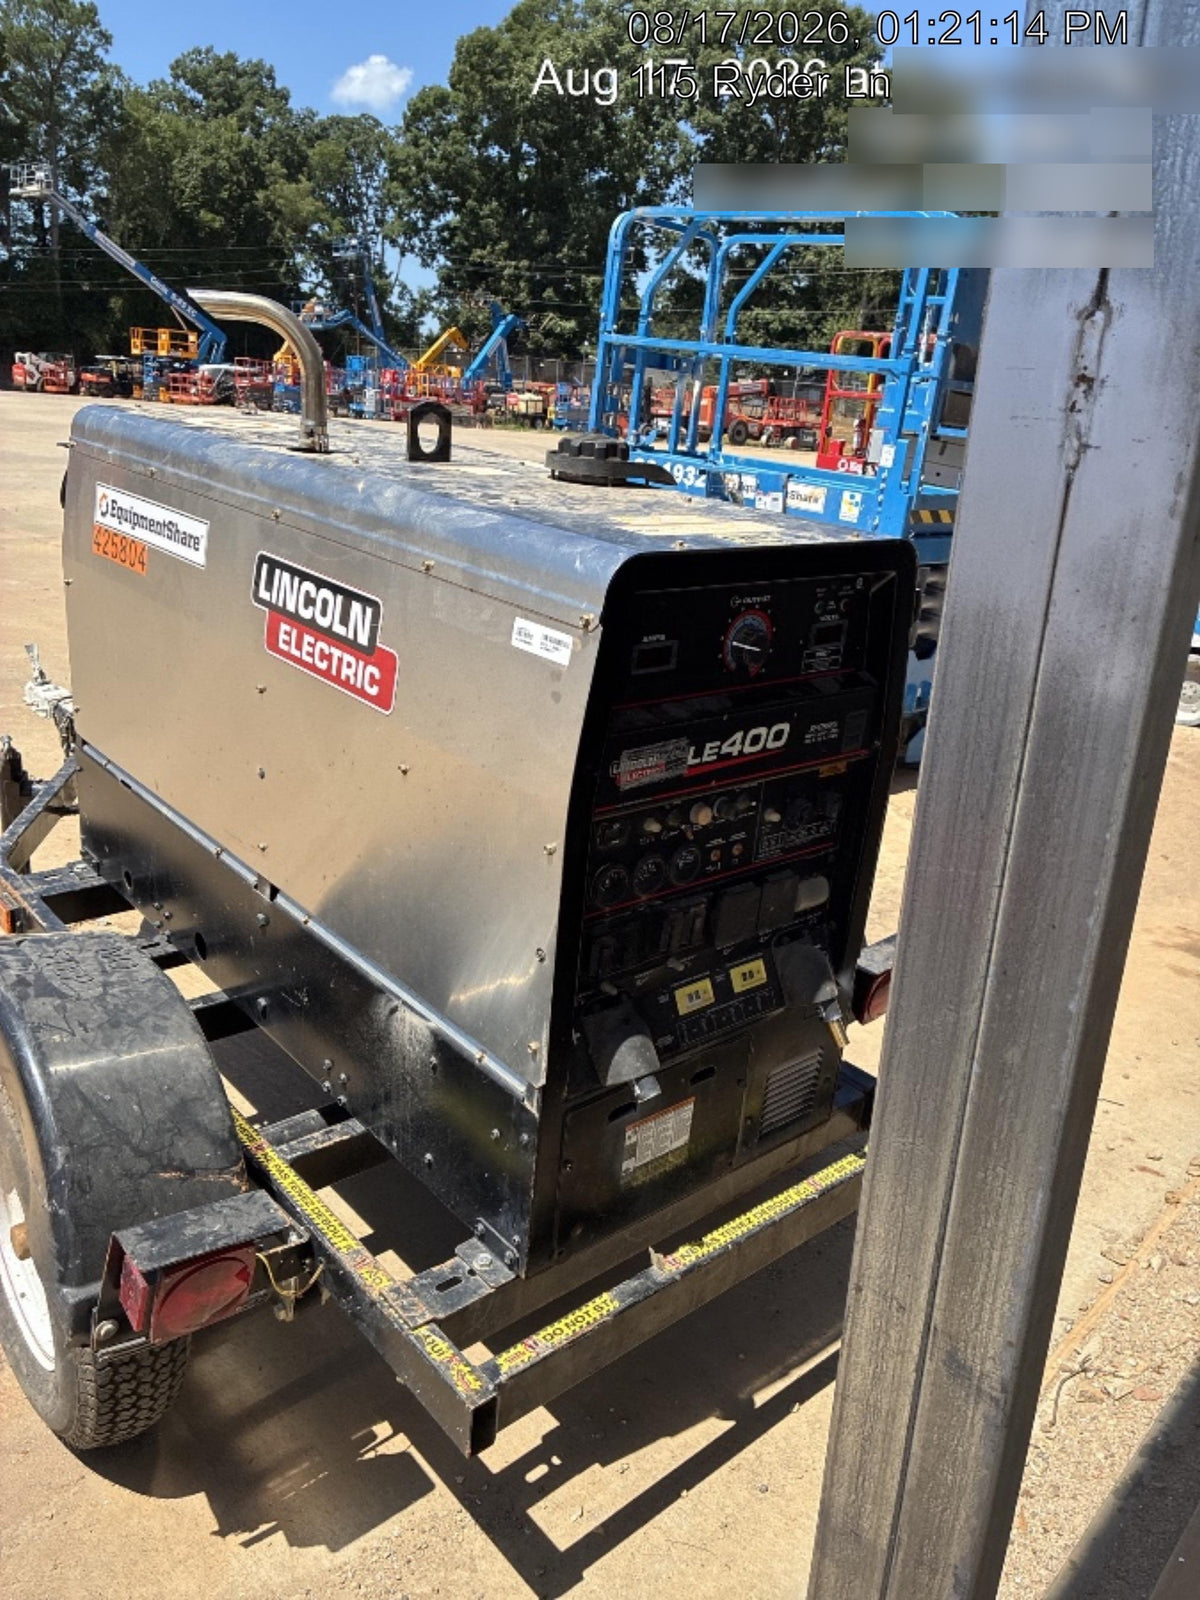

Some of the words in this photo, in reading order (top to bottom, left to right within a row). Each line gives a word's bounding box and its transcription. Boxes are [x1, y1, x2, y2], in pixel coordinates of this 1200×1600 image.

[92, 525, 147, 572] 425804
[110, 499, 200, 551] EquipmentShare
[258, 562, 374, 647] LINCOLN
[278, 621, 382, 697] ELECTRIC
[541, 1325, 565, 1343] DO
[564, 1309, 593, 1330] NOT
